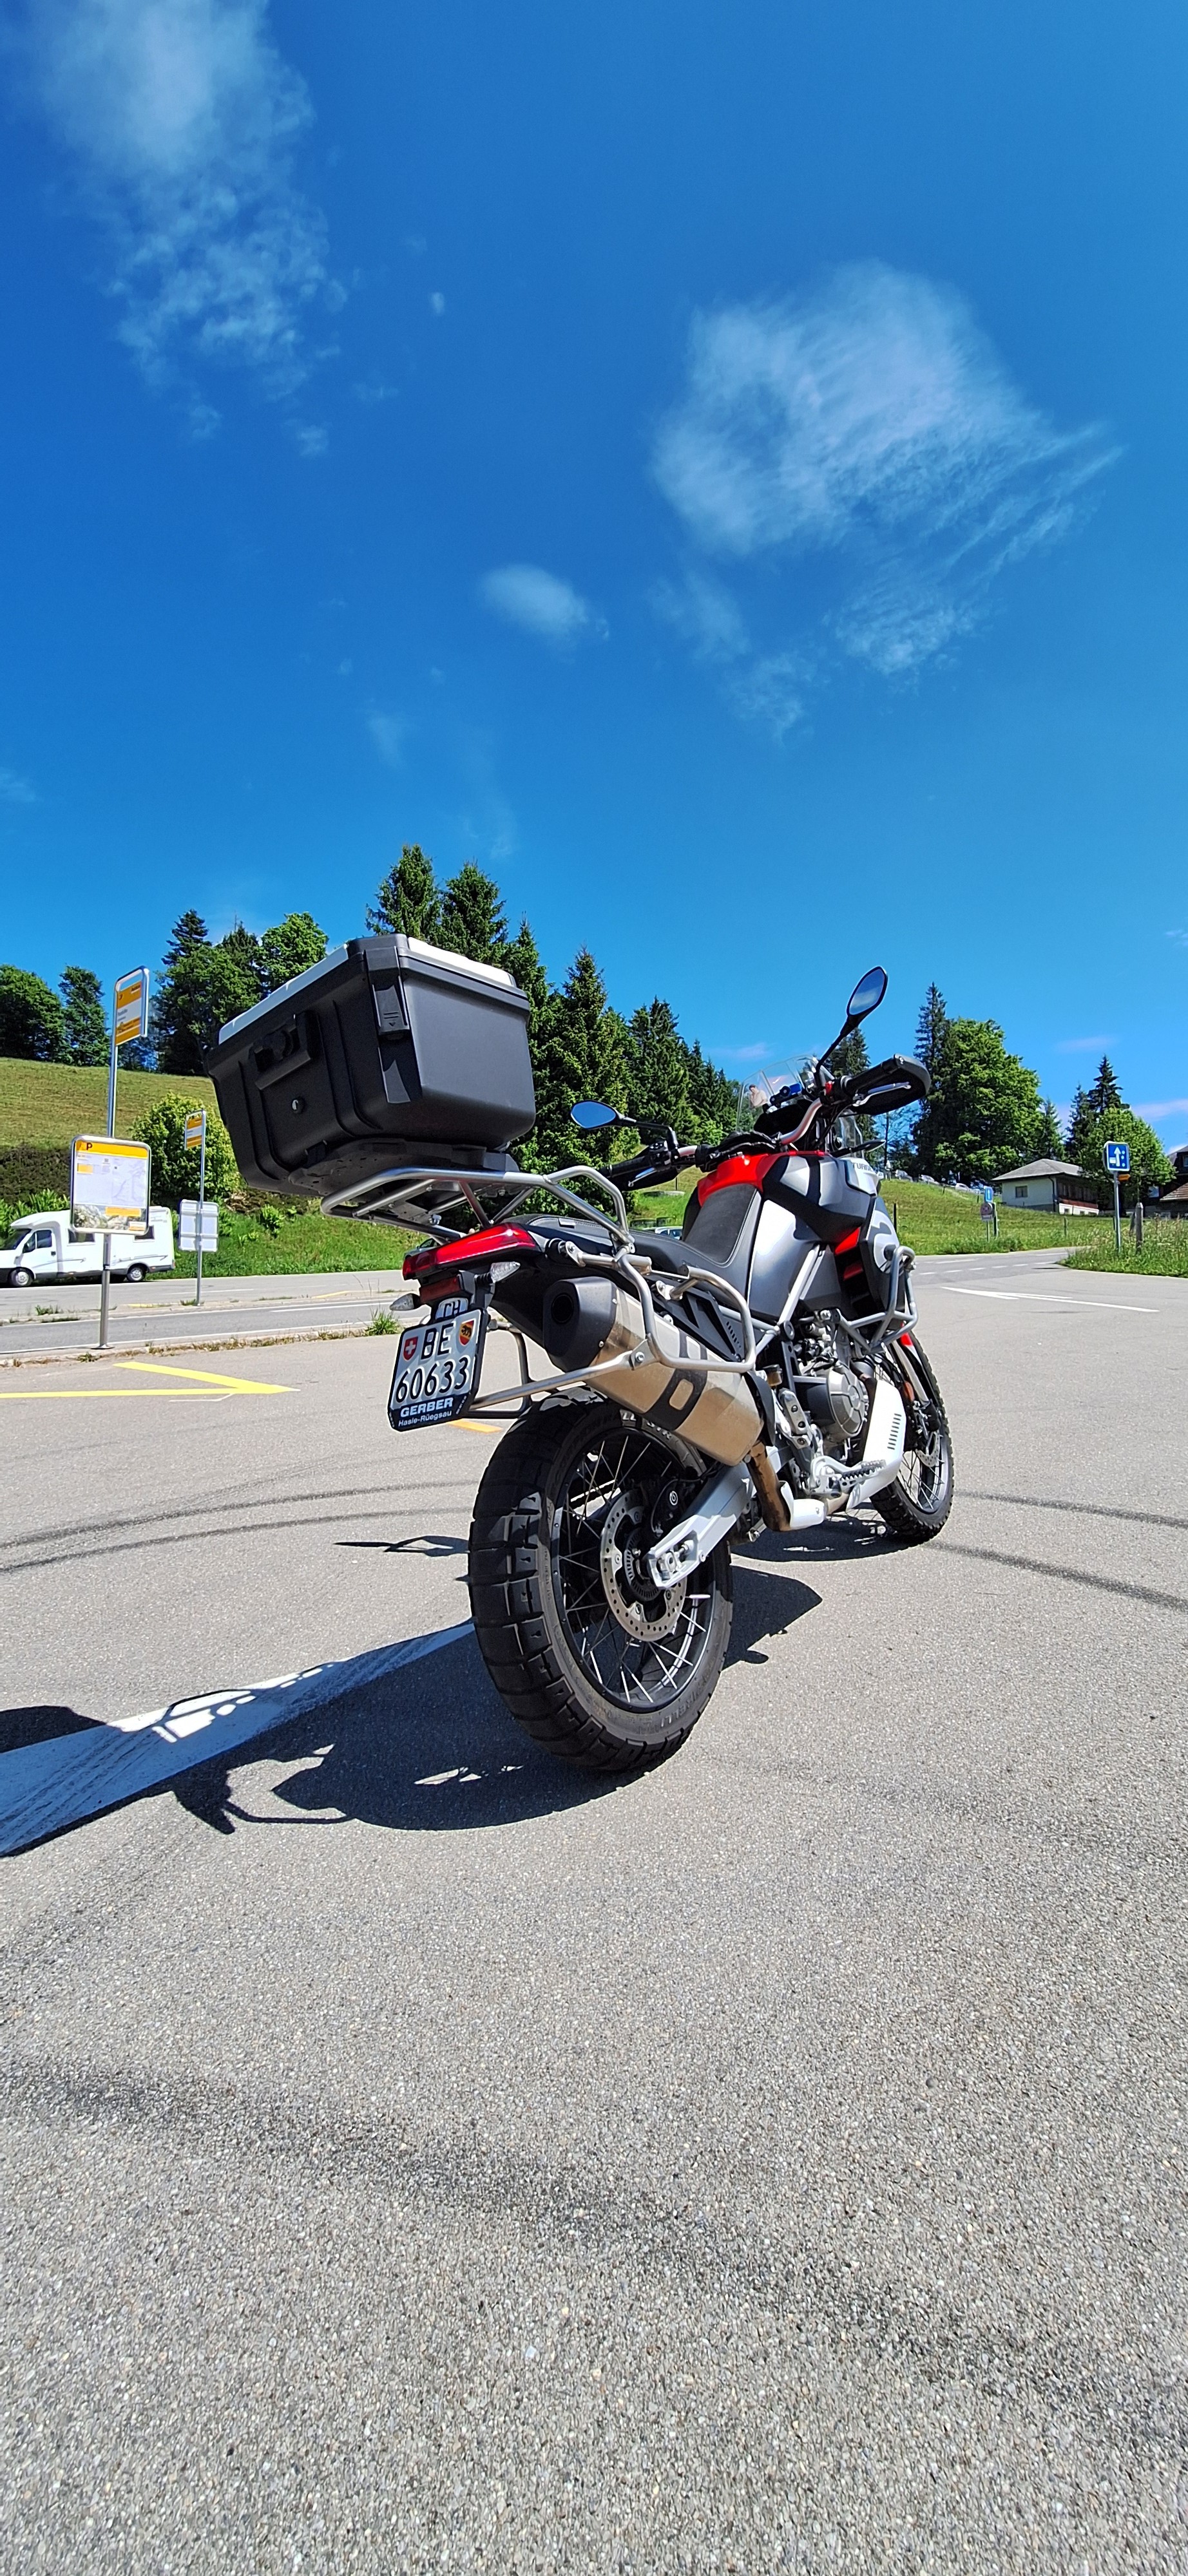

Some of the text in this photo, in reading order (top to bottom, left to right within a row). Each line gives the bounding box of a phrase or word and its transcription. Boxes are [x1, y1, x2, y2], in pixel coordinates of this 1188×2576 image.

[443, 1300, 460, 1317] CH
[421, 1324, 454, 1359] BE
[396, 1358, 468, 1403] 60633
[400, 1397, 454, 1417] GERBER
[398, 1410, 452, 1427] Hasle-Rüegsau
